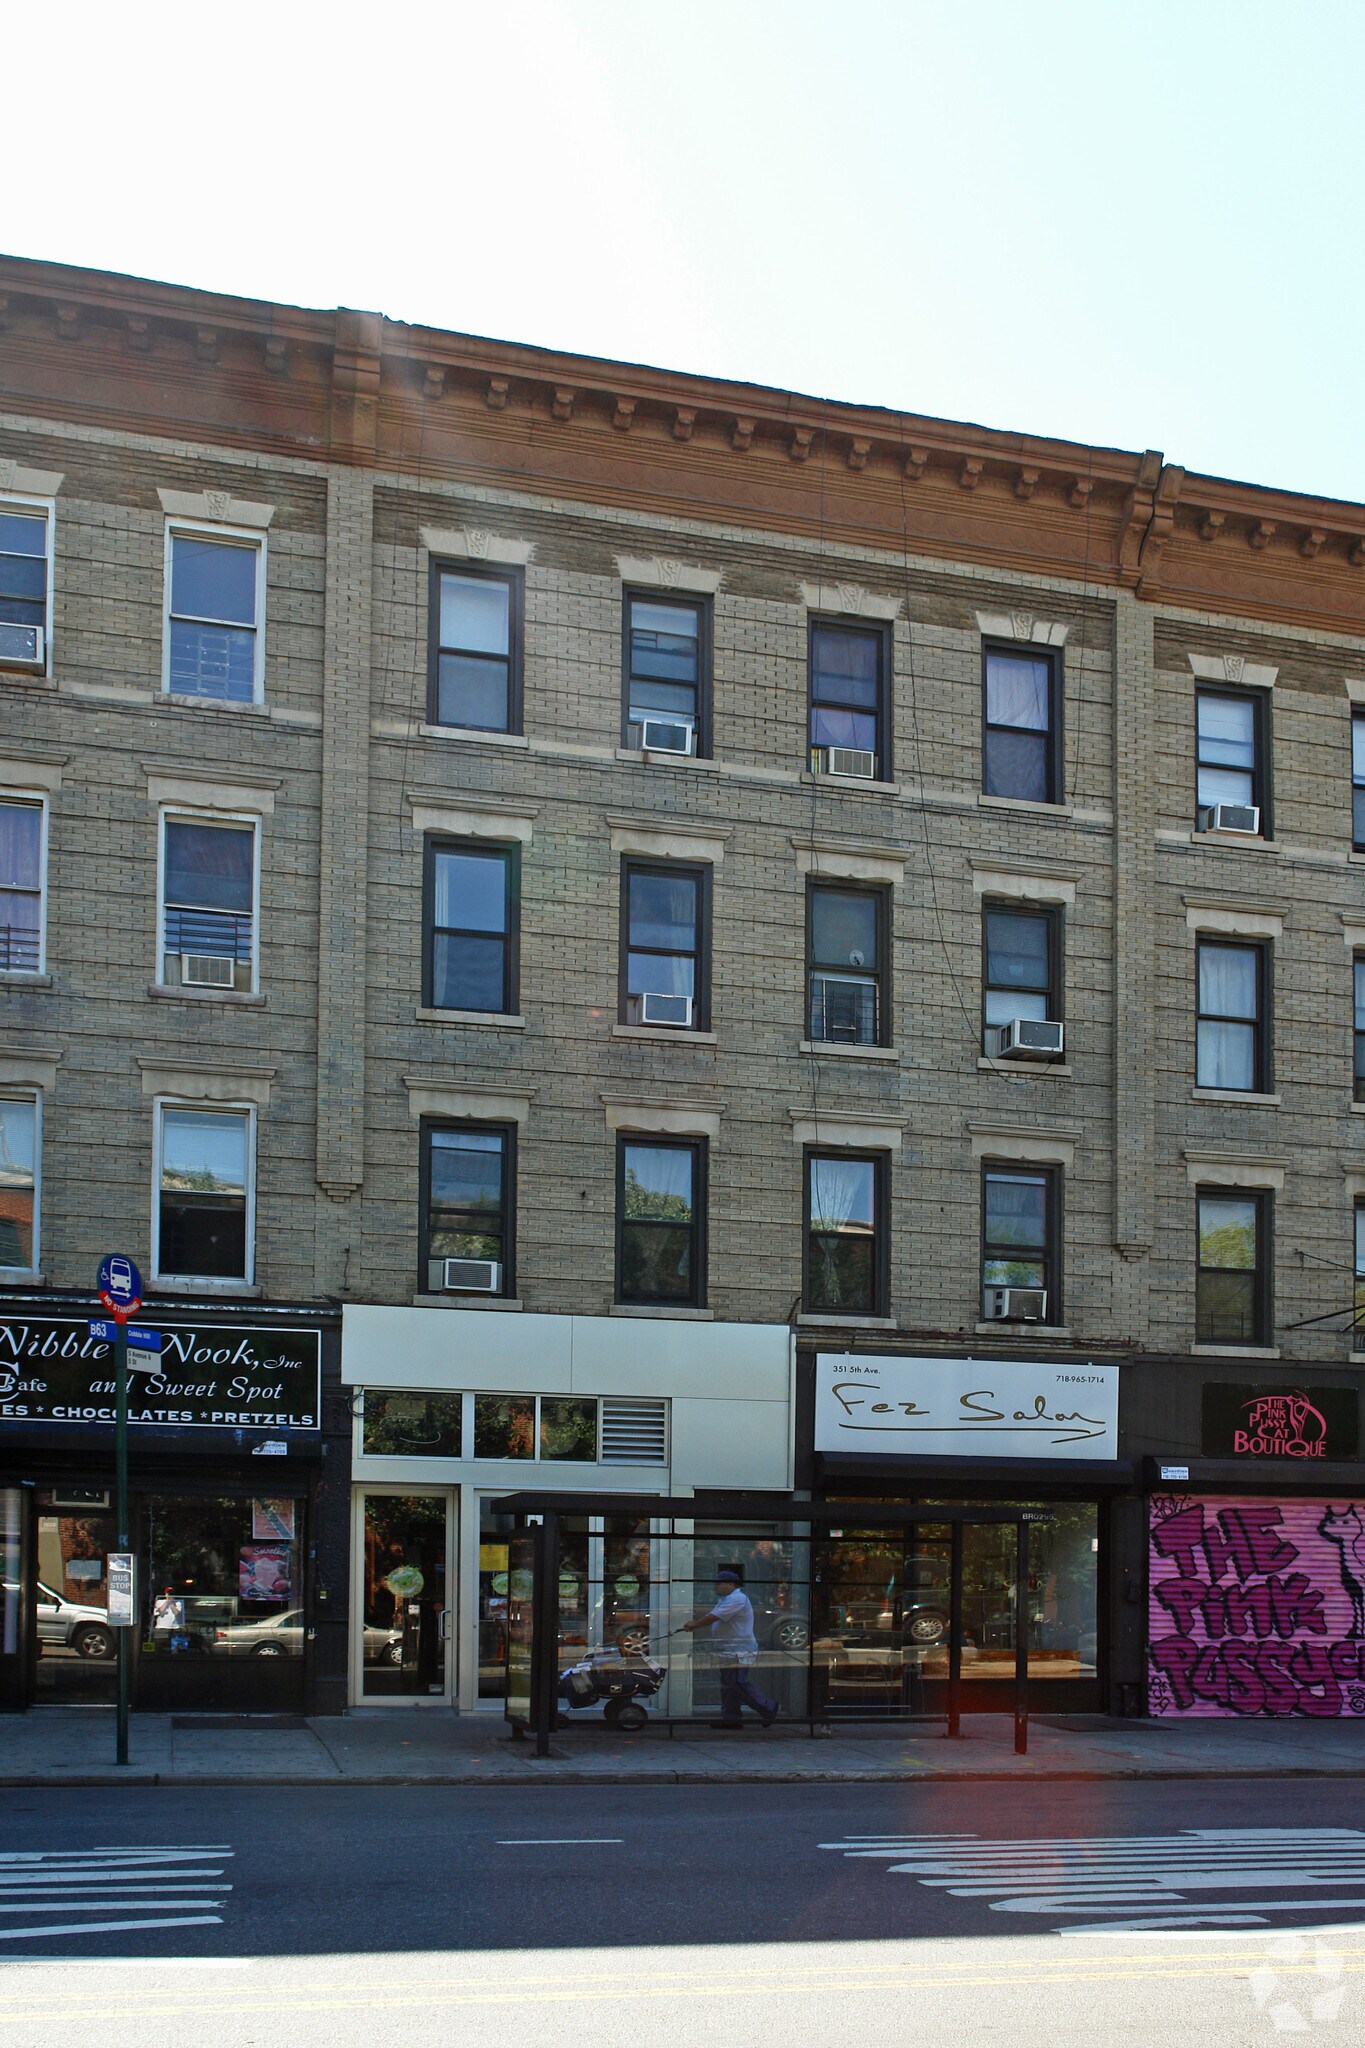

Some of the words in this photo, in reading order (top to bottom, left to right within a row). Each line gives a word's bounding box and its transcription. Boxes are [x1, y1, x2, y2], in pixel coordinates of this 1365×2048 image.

[103, 1294, 113, 1306] NO
[112, 1300, 139, 1314] STANDING
[90, 1322, 107, 1337] B63
[0, 1325, 109, 1360] Nibble
[161, 1332, 259, 1371] Nook,
[262, 1354, 302, 1370] Inc
[832, 1365, 847, 1373] 351
[849, 1366, 862, 1374] 5th
[863, 1367, 881, 1375] Ave.
[1055, 1375, 1105, 1384] 718-965-1714
[144, 1373, 218, 1397] Sweet
[226, 1376, 284, 1404] Spot
[831, 1382, 931, 1416] Fez
[958, 1390, 1107, 1425] Salon
[1256, 1402, 1287, 1419] PINK
[1267, 1398, 1285, 1409] THE
[211, 1411, 314, 1426] PRETZELS
[1249, 1412, 1287, 1429] PUSSY
[1234, 1430, 1328, 1457] BOUTIQUE
[1151, 1503, 1300, 1586] THE
[110, 1582, 131, 1590] STOP
[112, 1574, 129, 1582] BUS
